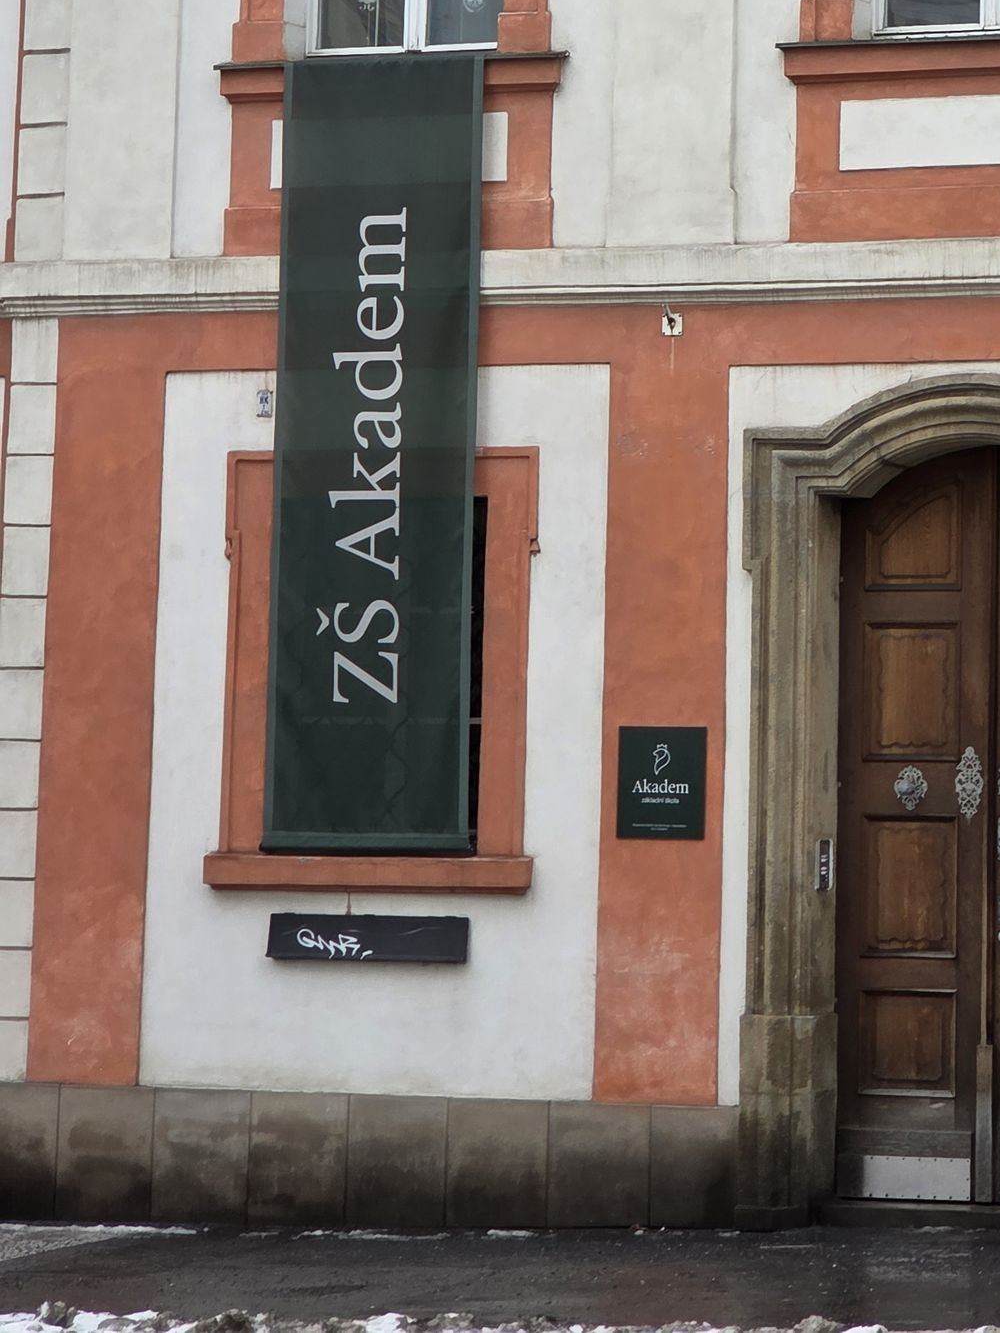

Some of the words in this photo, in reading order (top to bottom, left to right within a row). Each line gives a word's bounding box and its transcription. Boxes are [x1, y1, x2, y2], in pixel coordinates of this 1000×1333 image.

[328, 206, 408, 581] Akadem
[315, 598, 399, 705] ZŠ
[632, 779, 689, 794] Akadem
